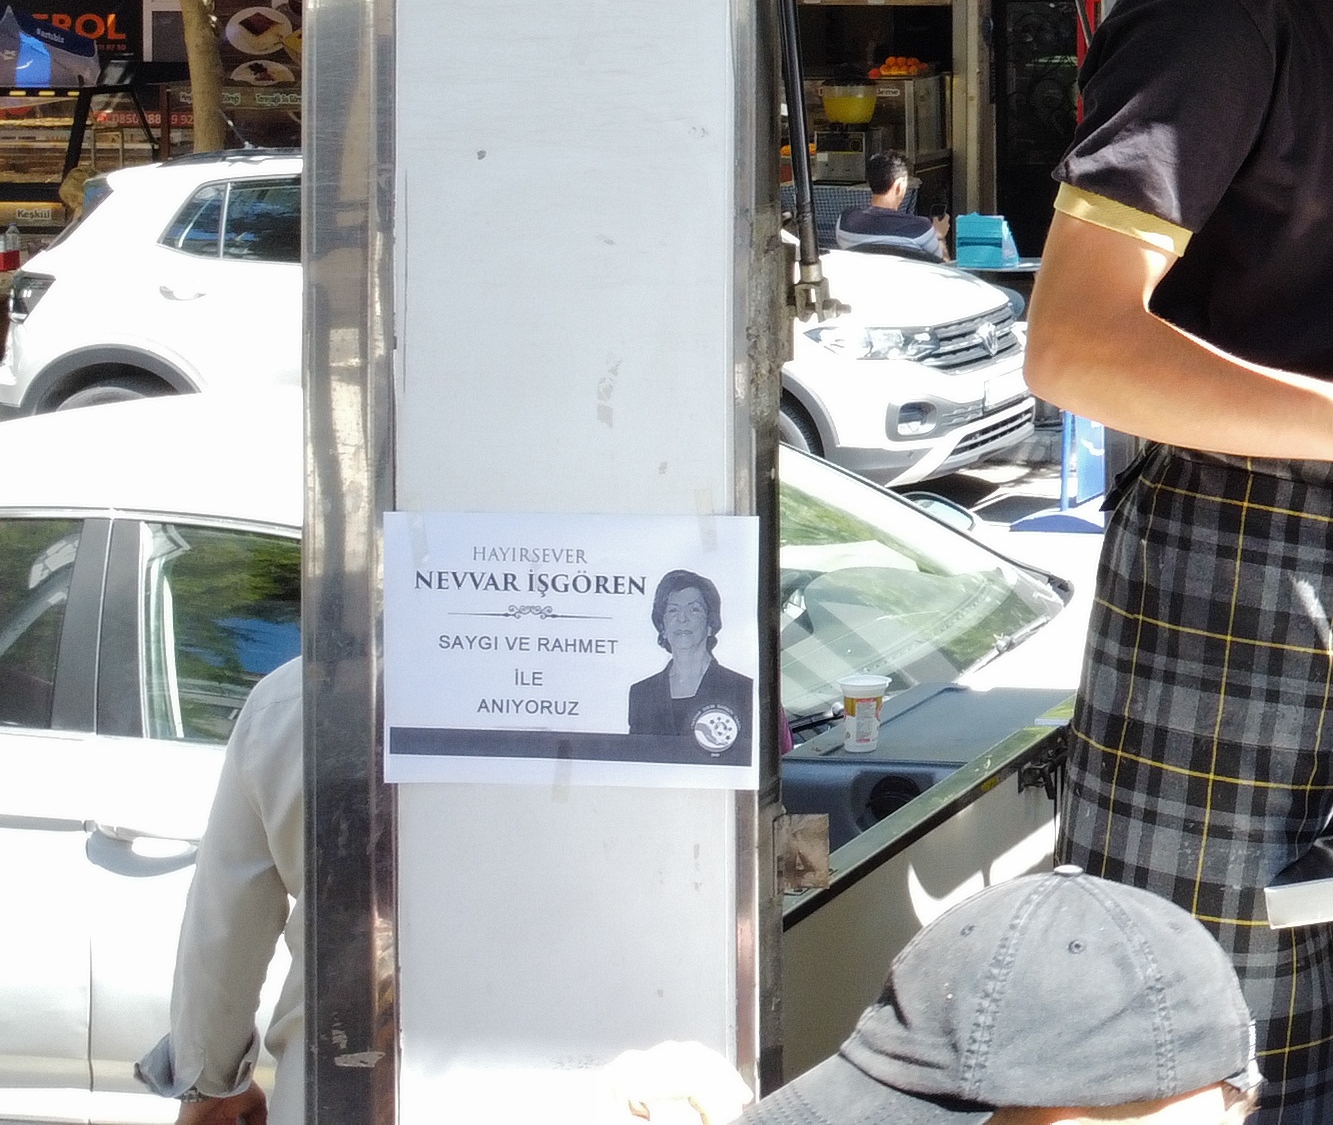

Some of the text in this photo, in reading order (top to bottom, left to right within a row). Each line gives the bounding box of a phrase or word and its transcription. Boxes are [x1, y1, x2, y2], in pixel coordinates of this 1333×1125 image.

[472, 546, 588, 564] HAYIRSEVER
[414, 568, 647, 598] NEVVAR İŞGÖREN
[438, 635, 619, 654] SAYGI VE RAHMET
[515, 669, 543, 686] İLE
[477, 699, 579, 716] ANIYORUZ
